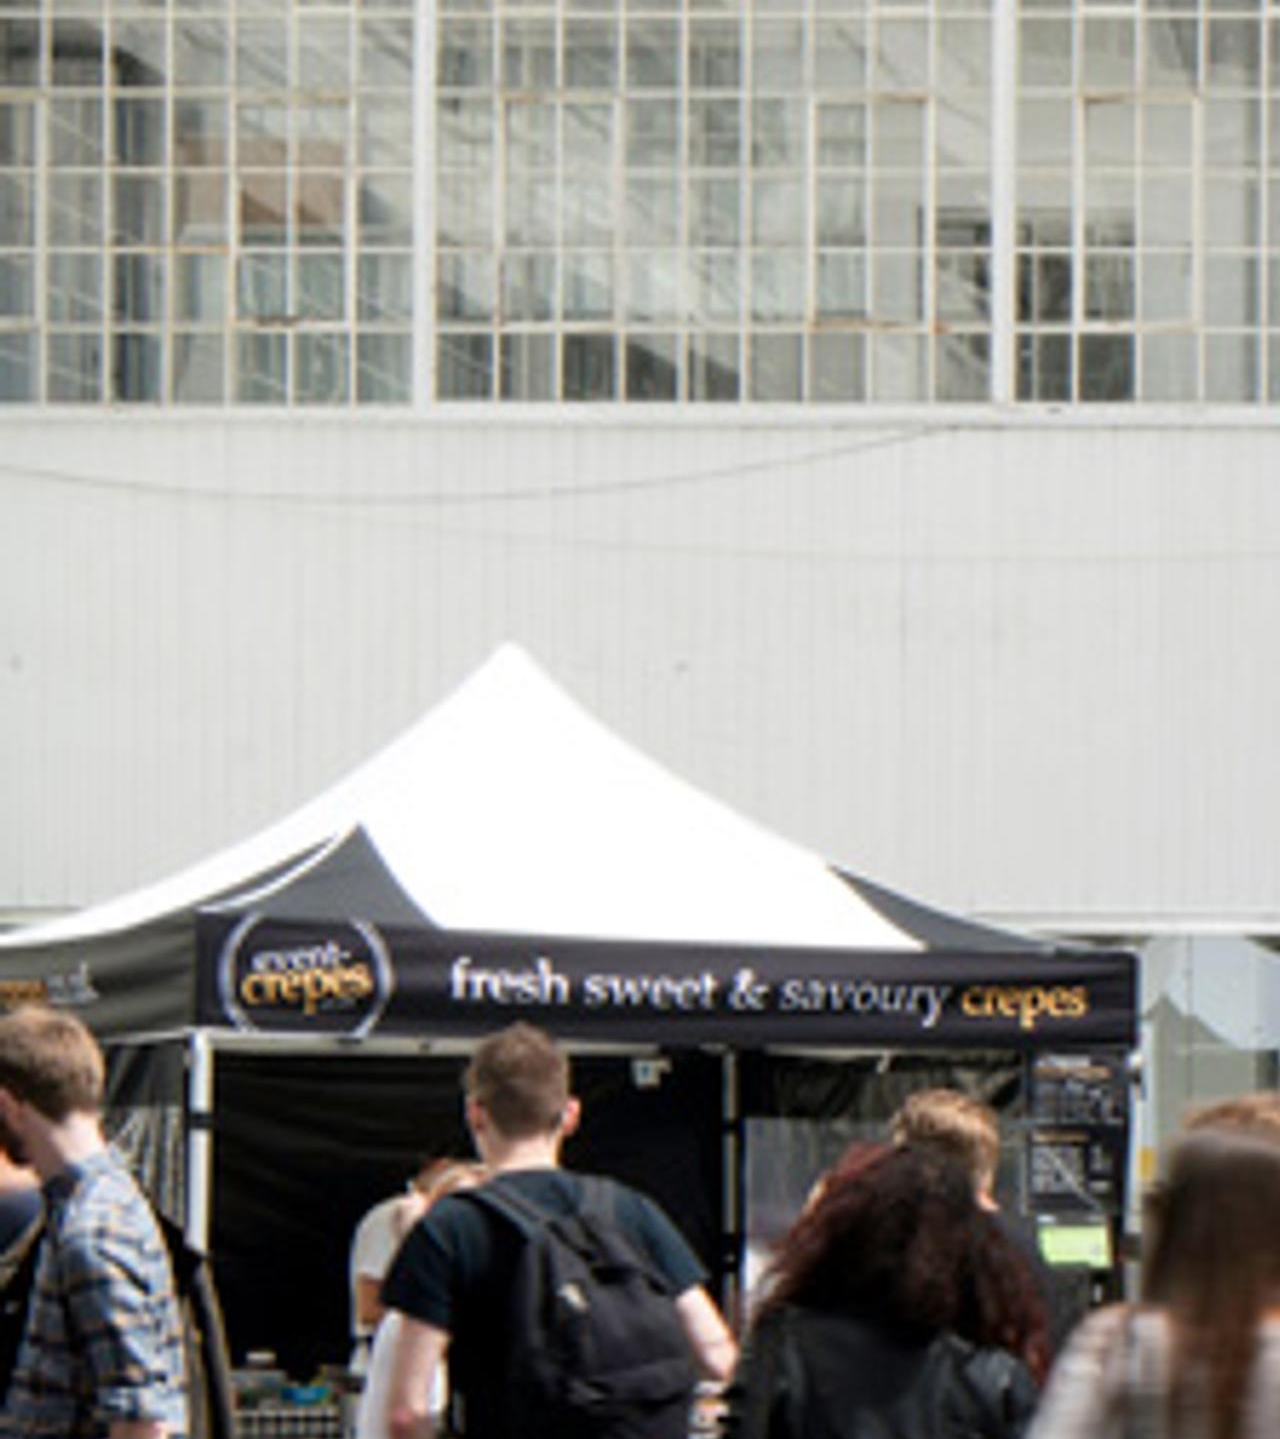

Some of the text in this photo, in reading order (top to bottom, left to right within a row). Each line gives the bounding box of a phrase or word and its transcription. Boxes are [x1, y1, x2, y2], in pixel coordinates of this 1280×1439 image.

[242, 962, 374, 1016] crepes
[452, 957, 1089, 1031] fresh sweet & savoury crepes
